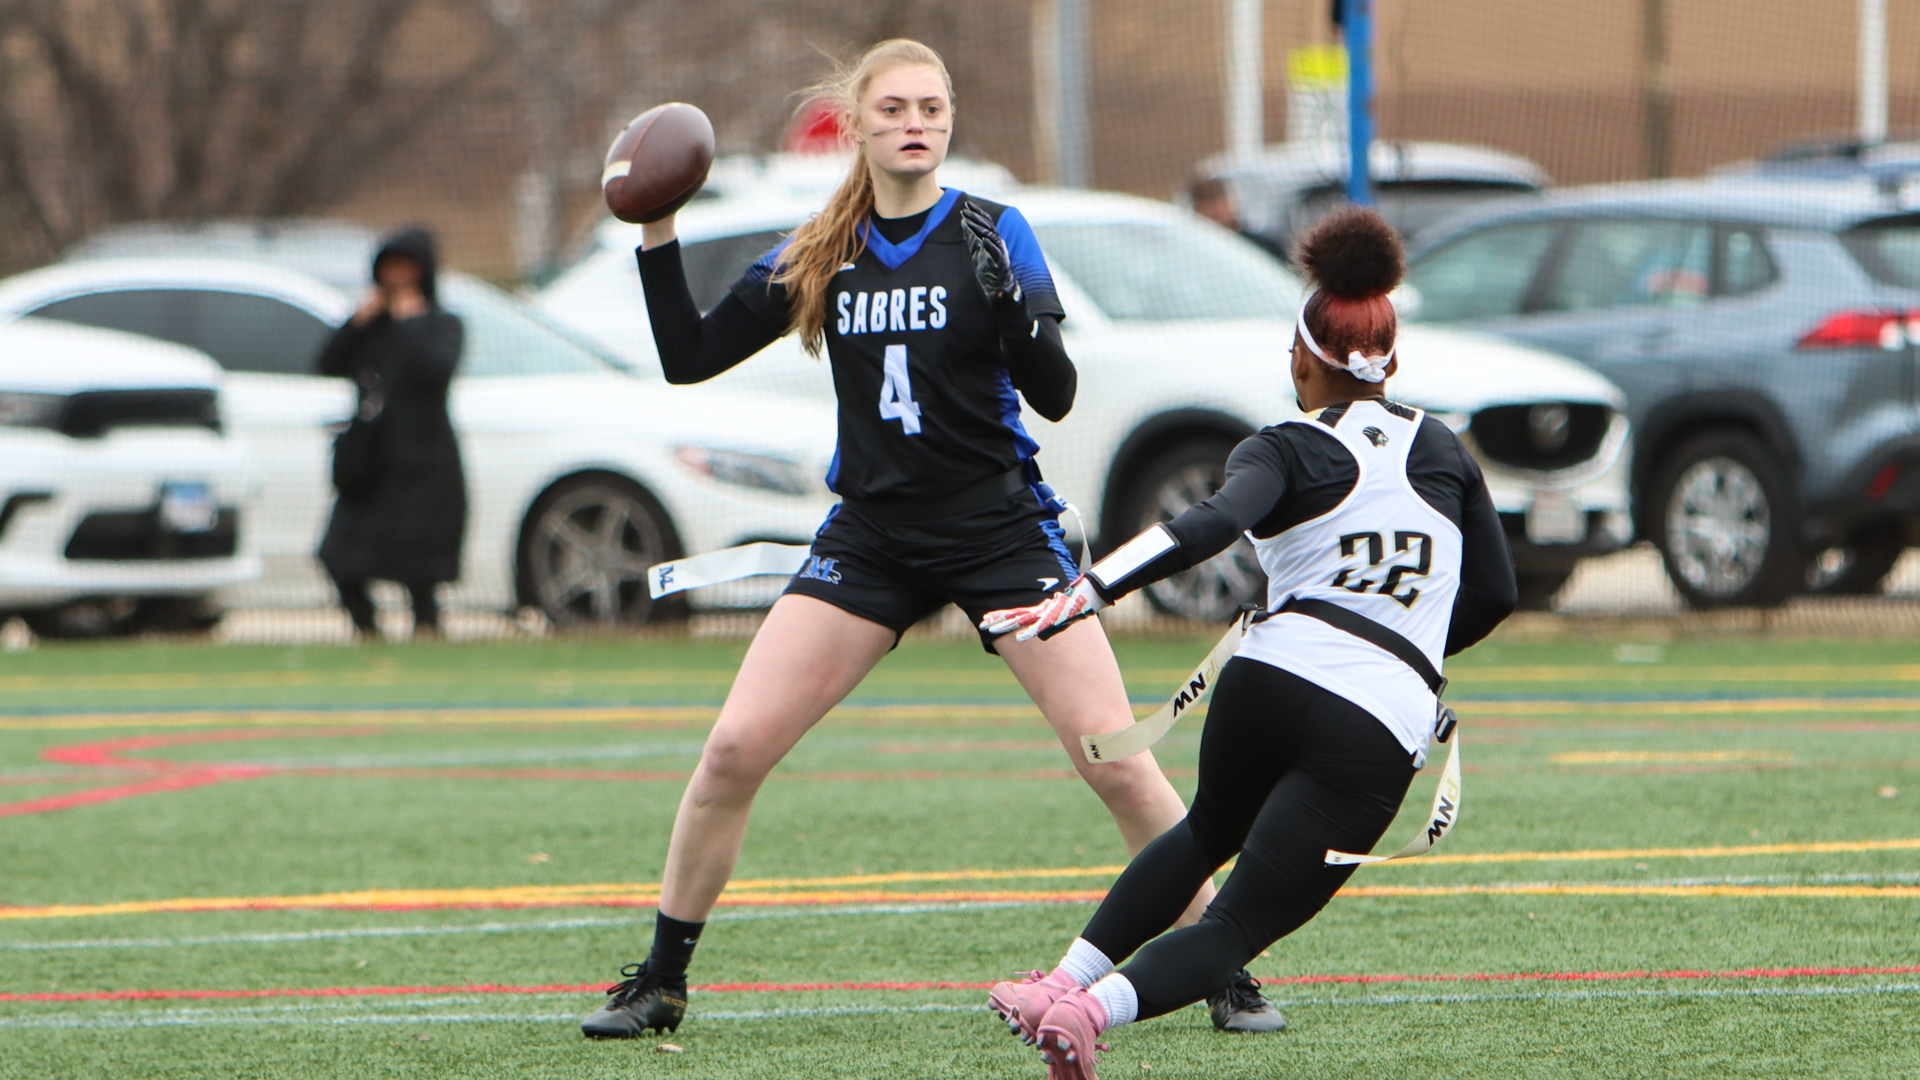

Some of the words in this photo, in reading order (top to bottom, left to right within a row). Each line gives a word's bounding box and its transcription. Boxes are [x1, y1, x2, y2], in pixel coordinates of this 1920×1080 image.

[837, 286, 947, 335] SABRES
[879, 344, 922, 435] 4
[1329, 530, 1432, 610] 22
[1173, 658, 1216, 719] PNW
[1428, 778, 1459, 847] PNW
